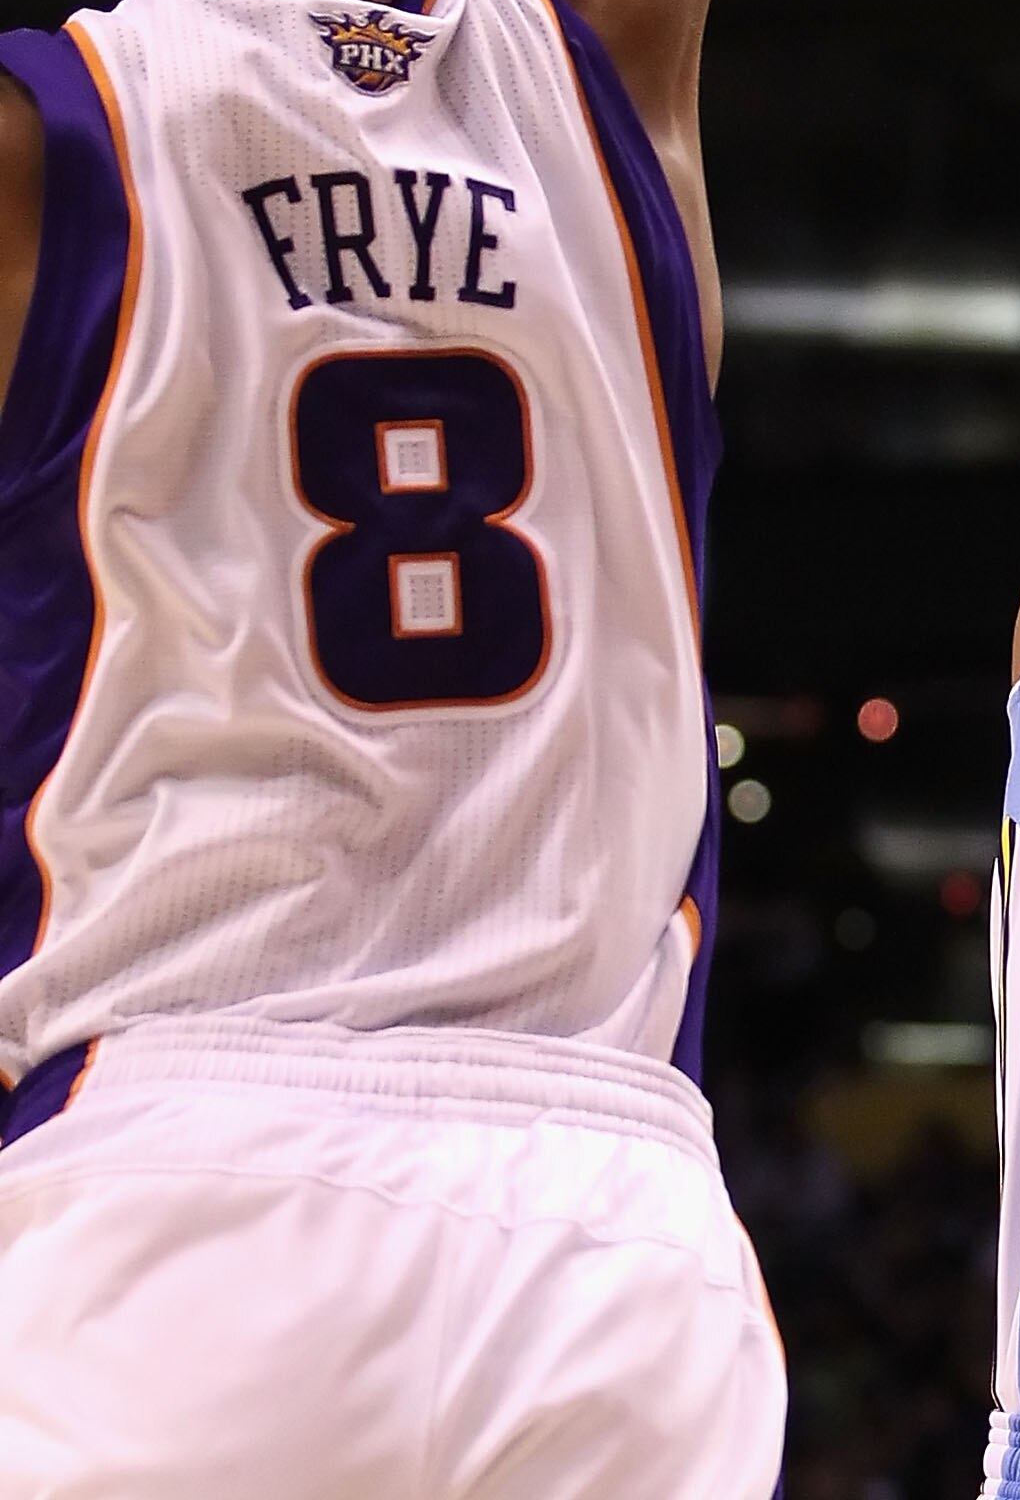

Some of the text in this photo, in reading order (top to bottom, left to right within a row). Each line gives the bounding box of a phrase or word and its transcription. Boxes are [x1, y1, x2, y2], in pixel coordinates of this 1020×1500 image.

[339, 43, 406, 75] PHX
[241, 167, 517, 311] FRYE
[288, 347, 554, 713] 8
